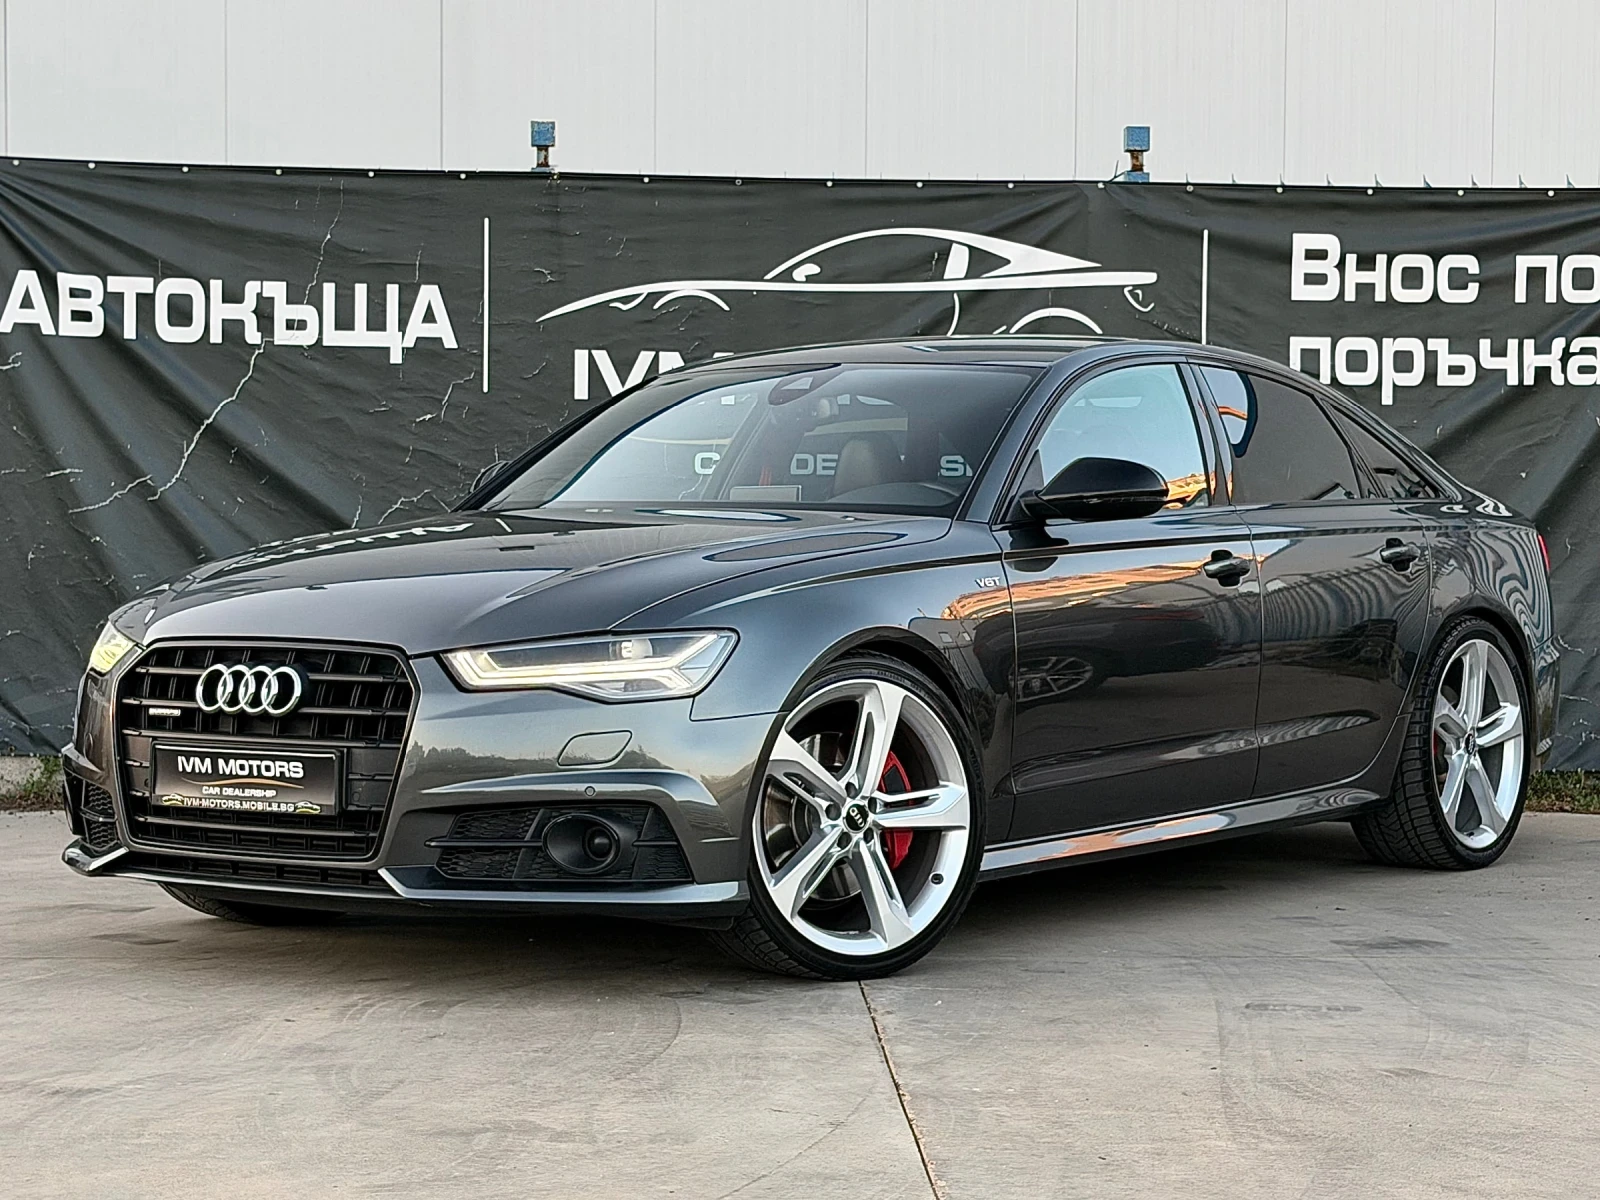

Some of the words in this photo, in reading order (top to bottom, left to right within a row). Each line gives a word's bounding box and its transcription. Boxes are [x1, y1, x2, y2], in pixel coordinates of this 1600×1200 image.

[1291, 232, 1480, 303] Внос
[1514, 254, 1600, 304] по
[0, 269, 458, 364] АВТОКЪЩА
[1289, 336, 1600, 406] поръчка
[975, 576, 1000, 588] V6T
[177, 755, 213, 774] IVM
[218, 758, 304, 778] MOTORS
[202, 786, 221, 795] CAR
[222, 786, 277, 798] DEALERSHIP
[183, 797, 295, 812] IVM-MOTORS.MOBILE.BG
